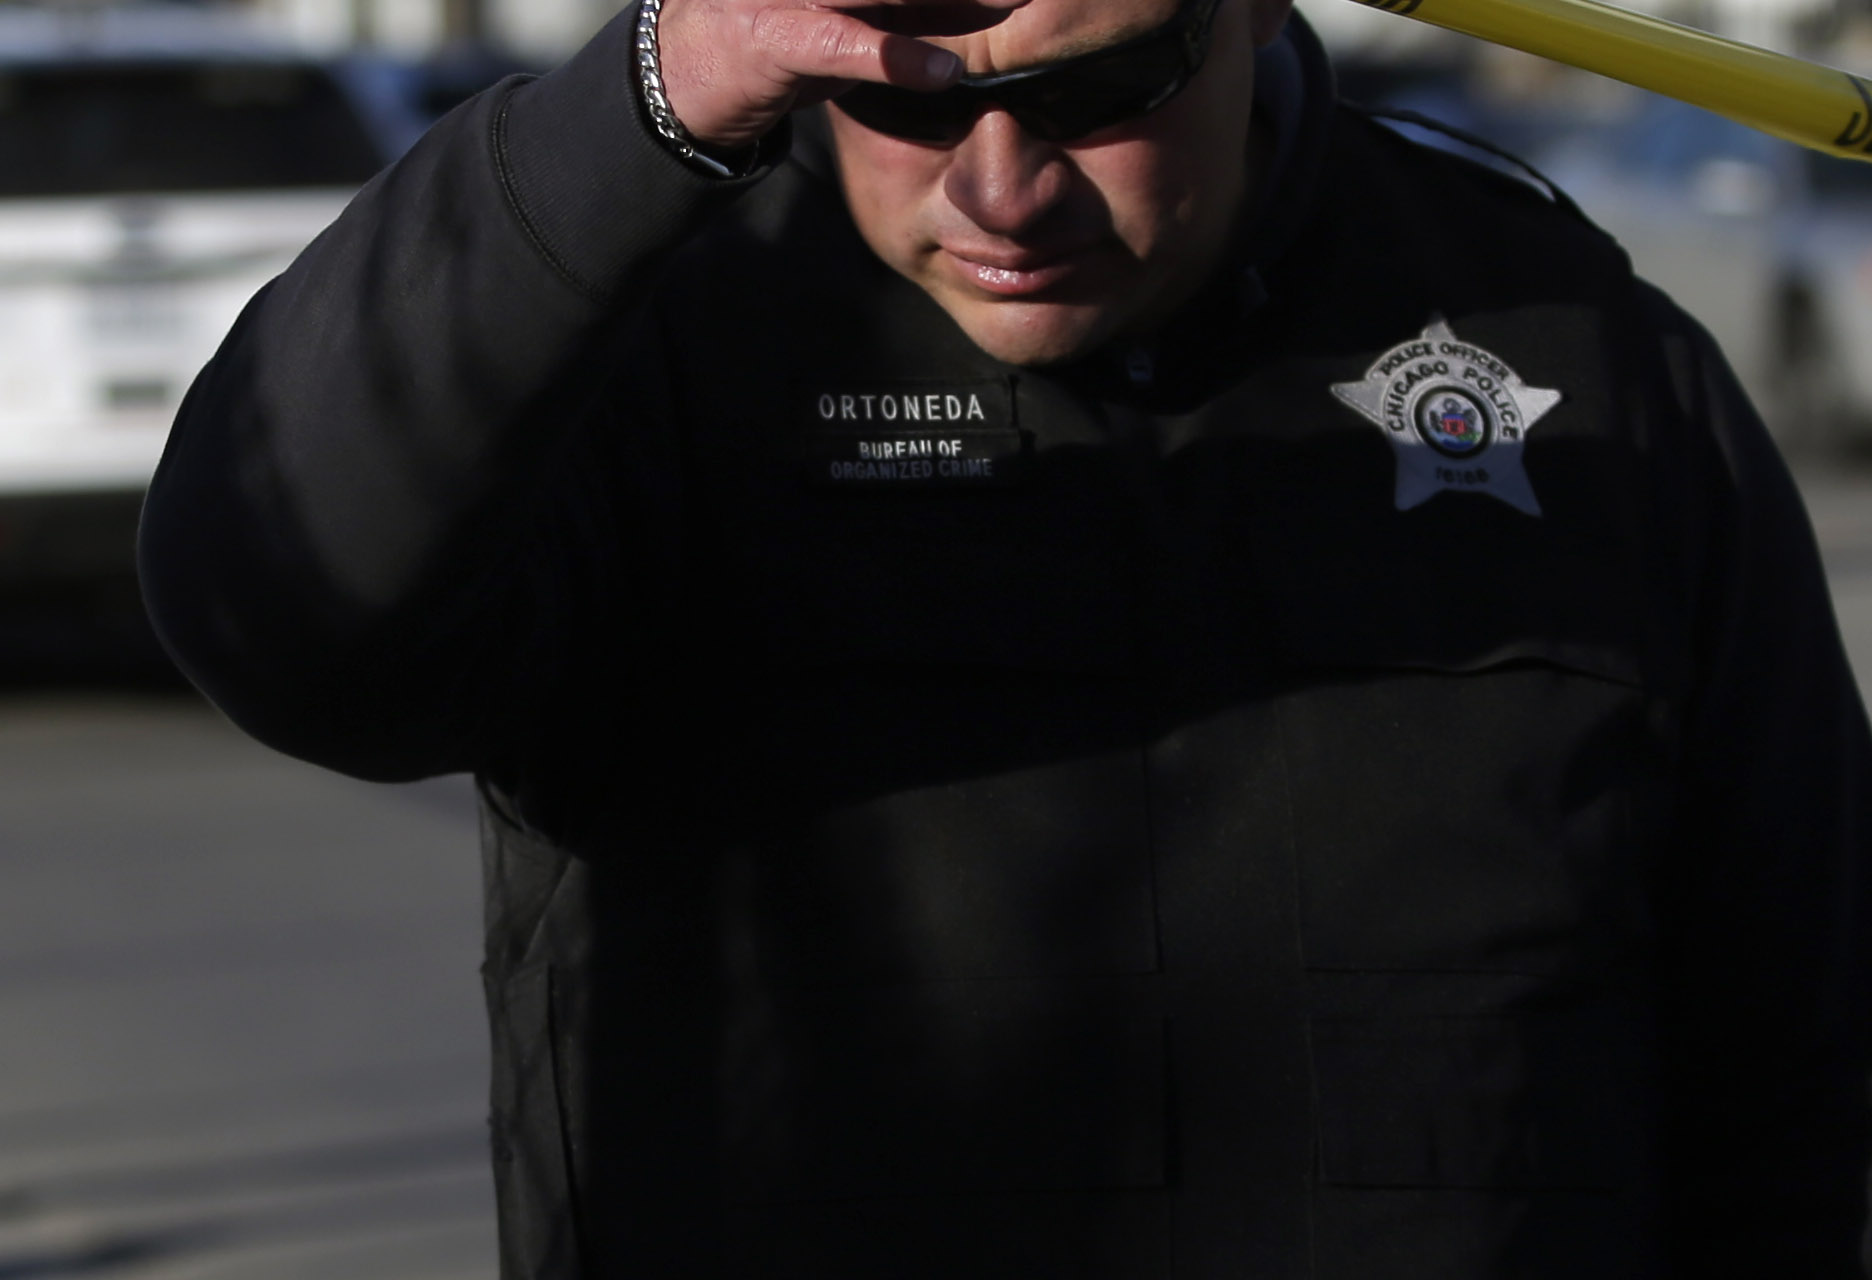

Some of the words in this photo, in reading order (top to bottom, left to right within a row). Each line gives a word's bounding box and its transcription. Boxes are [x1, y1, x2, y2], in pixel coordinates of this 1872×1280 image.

[1380, 342, 1436, 377] POLICE
[1439, 341, 1510, 382] OFFICER
[817, 392, 986, 421] ORTONEDA
[1386, 360, 1449, 433] CHICAGO
[1462, 367, 1518, 440] POLICE
[858, 439, 932, 461] BUREAU
[936, 438, 963, 458] OF
[829, 460, 933, 481] ORGANIZED
[938, 457, 994, 478] CRIME
